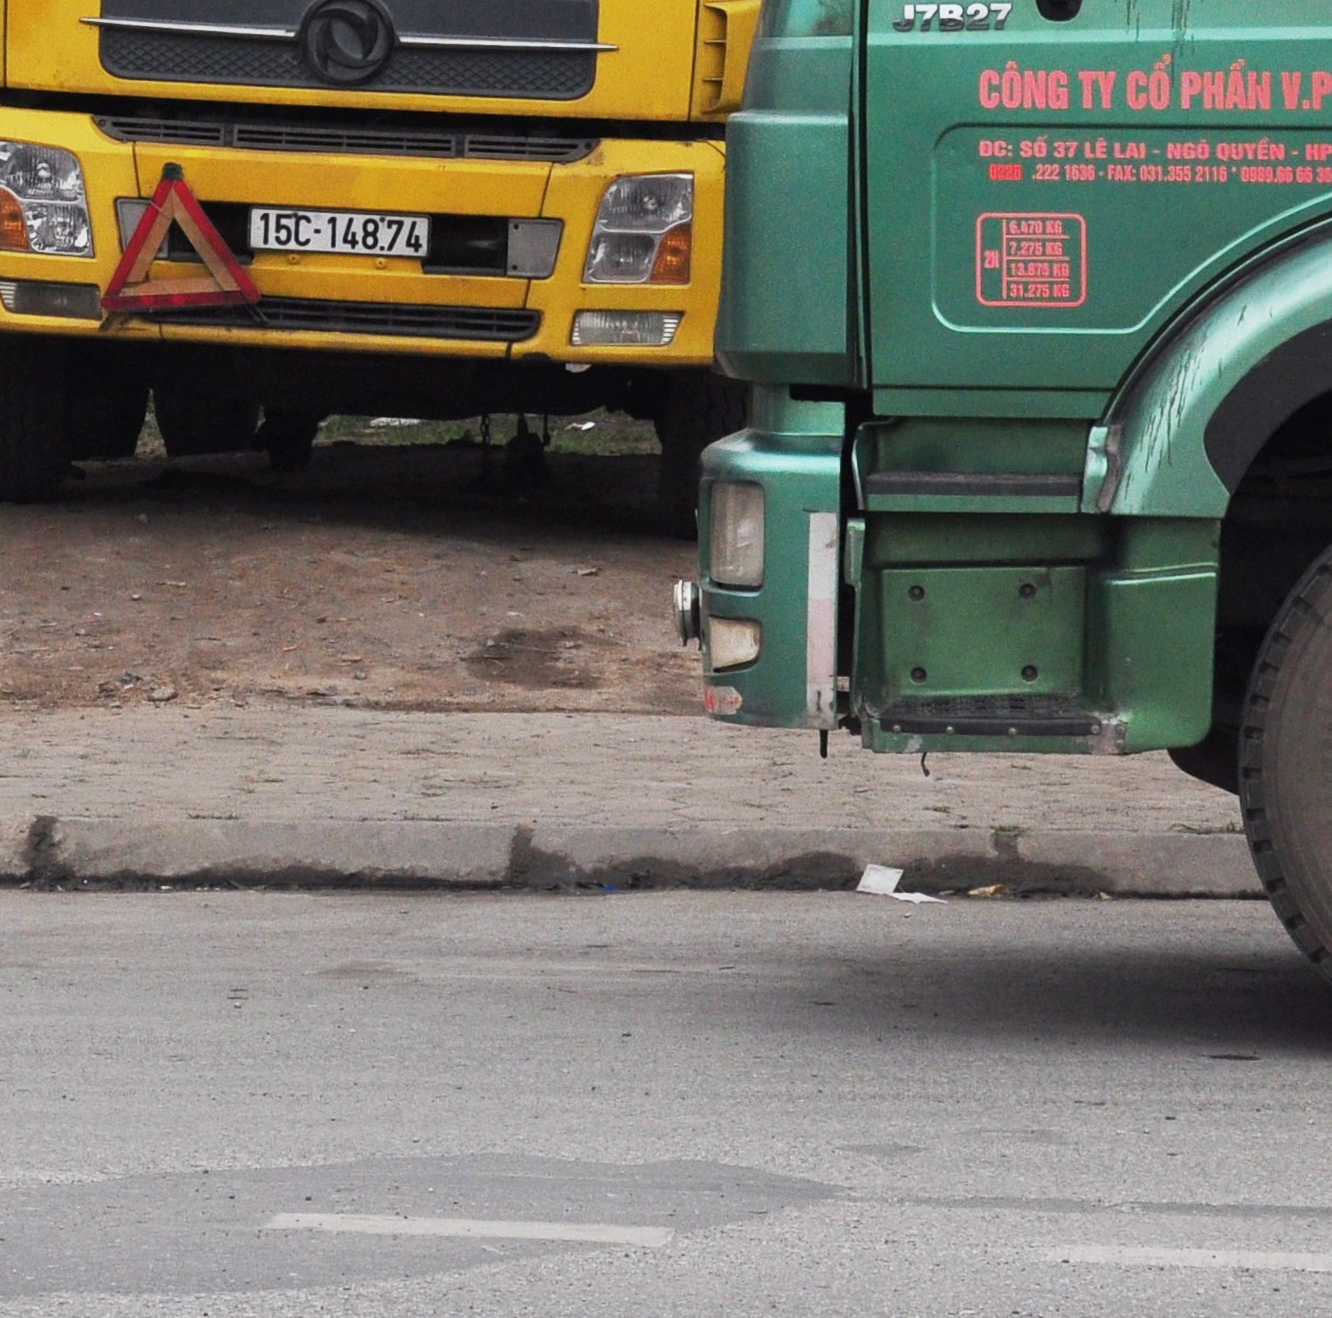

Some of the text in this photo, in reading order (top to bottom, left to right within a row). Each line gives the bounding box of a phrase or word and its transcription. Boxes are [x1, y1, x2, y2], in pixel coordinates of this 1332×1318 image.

[892, 2, 1013, 32] J7B27
[979, 61, 1069, 110] CÔNG
[1078, 70, 1117, 110] TY
[1126, 54, 1172, 110] CỔ
[979, 140, 1013, 158] ĐC:
[1019, 135, 1048, 159] SỐ
[1052, 141, 1077, 159] 37
[1083, 138, 1107, 160] LÊ
[1113, 142, 1147, 160] LAI
[1166, 137, 1211, 161] NGÔ
[1108, 164, 1137, 182] FAX:
[1195, 164, 1228, 182] 2116
[259, 212, 423, 253] 15C-148.74
